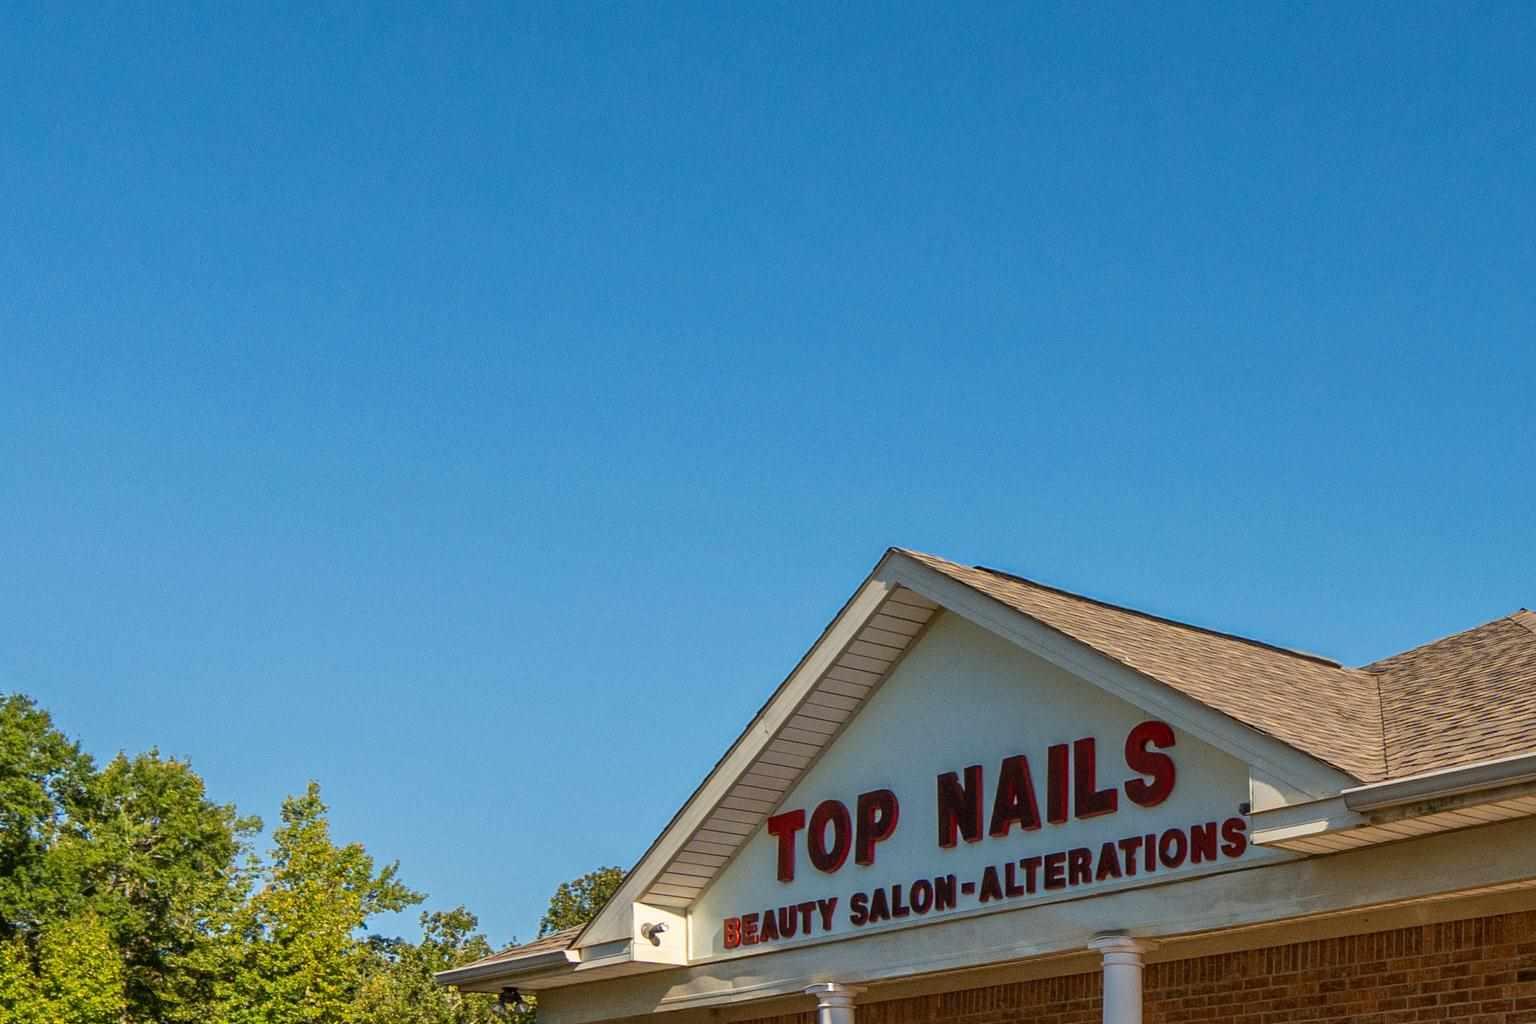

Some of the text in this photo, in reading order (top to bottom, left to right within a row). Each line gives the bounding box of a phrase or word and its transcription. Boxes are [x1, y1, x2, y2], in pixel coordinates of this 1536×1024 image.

[767, 719, 1176, 883] TOP NAILS
[723, 897, 838, 949] BEAUTY
